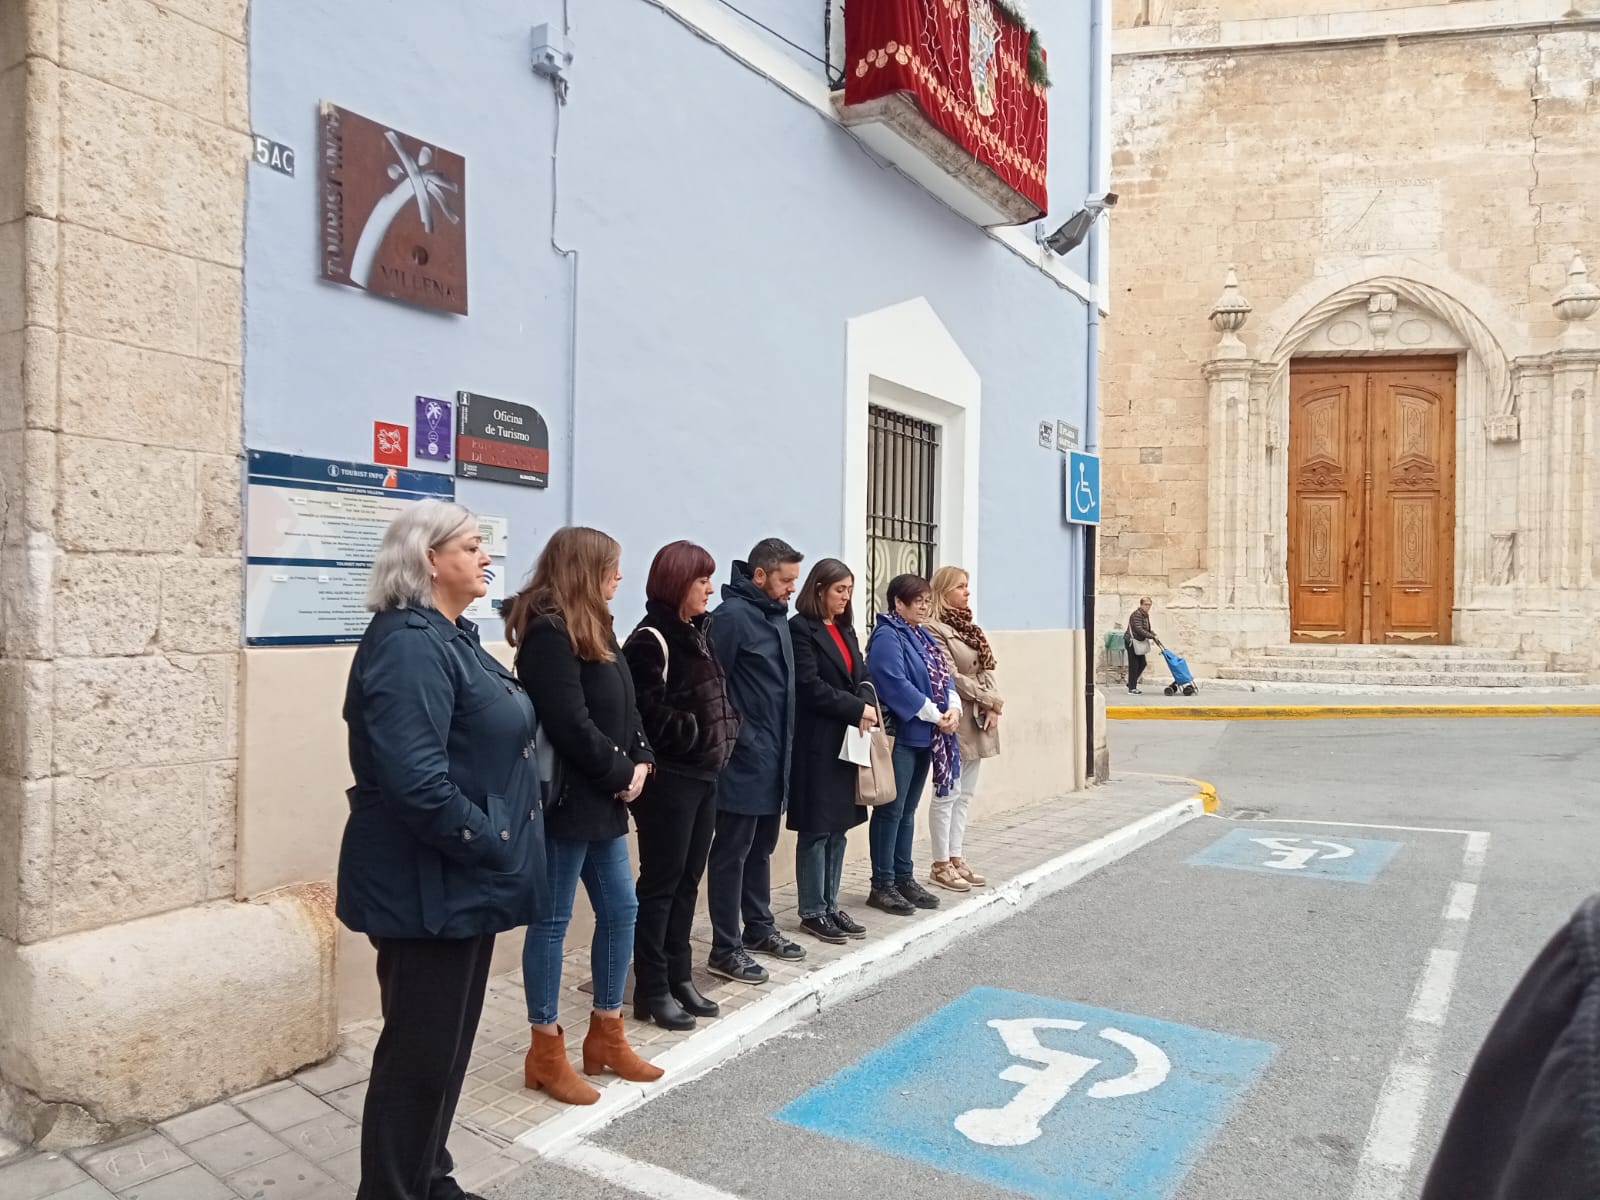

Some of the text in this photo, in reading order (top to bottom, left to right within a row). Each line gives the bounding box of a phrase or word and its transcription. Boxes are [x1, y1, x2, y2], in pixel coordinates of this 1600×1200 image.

[256, 137, 293, 174] 5AC
[381, 264, 457, 303] VILLENA
[493, 409, 523, 425] Oficina
[485, 424, 530, 441] de Turismo
[341, 468, 384, 480] TOURIST INFO
